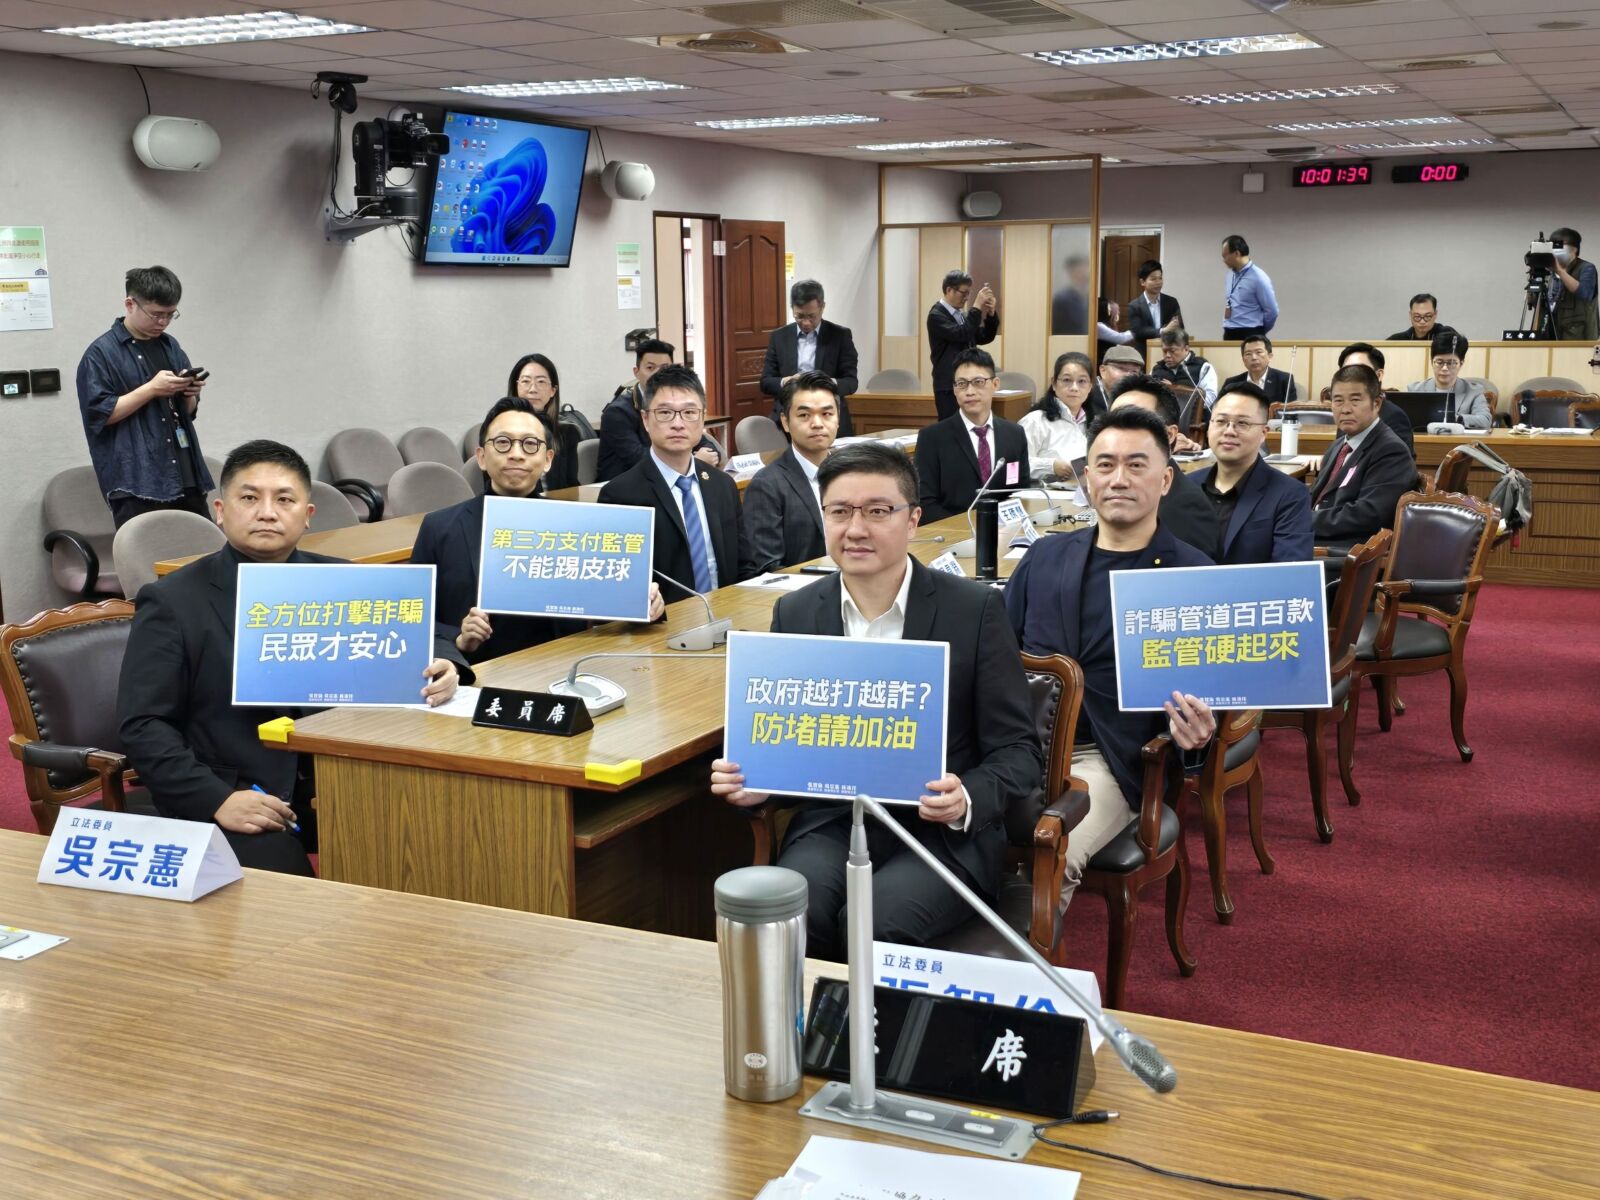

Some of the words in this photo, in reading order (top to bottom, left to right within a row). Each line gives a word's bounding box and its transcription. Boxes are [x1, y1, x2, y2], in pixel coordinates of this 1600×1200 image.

[1300, 167, 1368, 184] 10:01:39
[1420, 165, 1457, 181] 0:00
[491, 528, 645, 554] 第三方支付監管
[502, 555, 632, 581] 不能踢皮球
[246, 598, 424, 629] 全方位打擊詐騙
[1124, 597, 1315, 635] 詐騙管道百百款
[258, 630, 407, 662] 民眾才安心
[1142, 630, 1299, 669] 監管硬起來
[745, 676, 932, 711] 政府越打越詐?
[485, 697, 566, 724] 委員席
[751, 711, 918, 750] 防堵請加油
[70, 817, 113, 832] 立法委員
[55, 835, 189, 888] 吳宗憲
[882, 953, 944, 975] 立法委員
